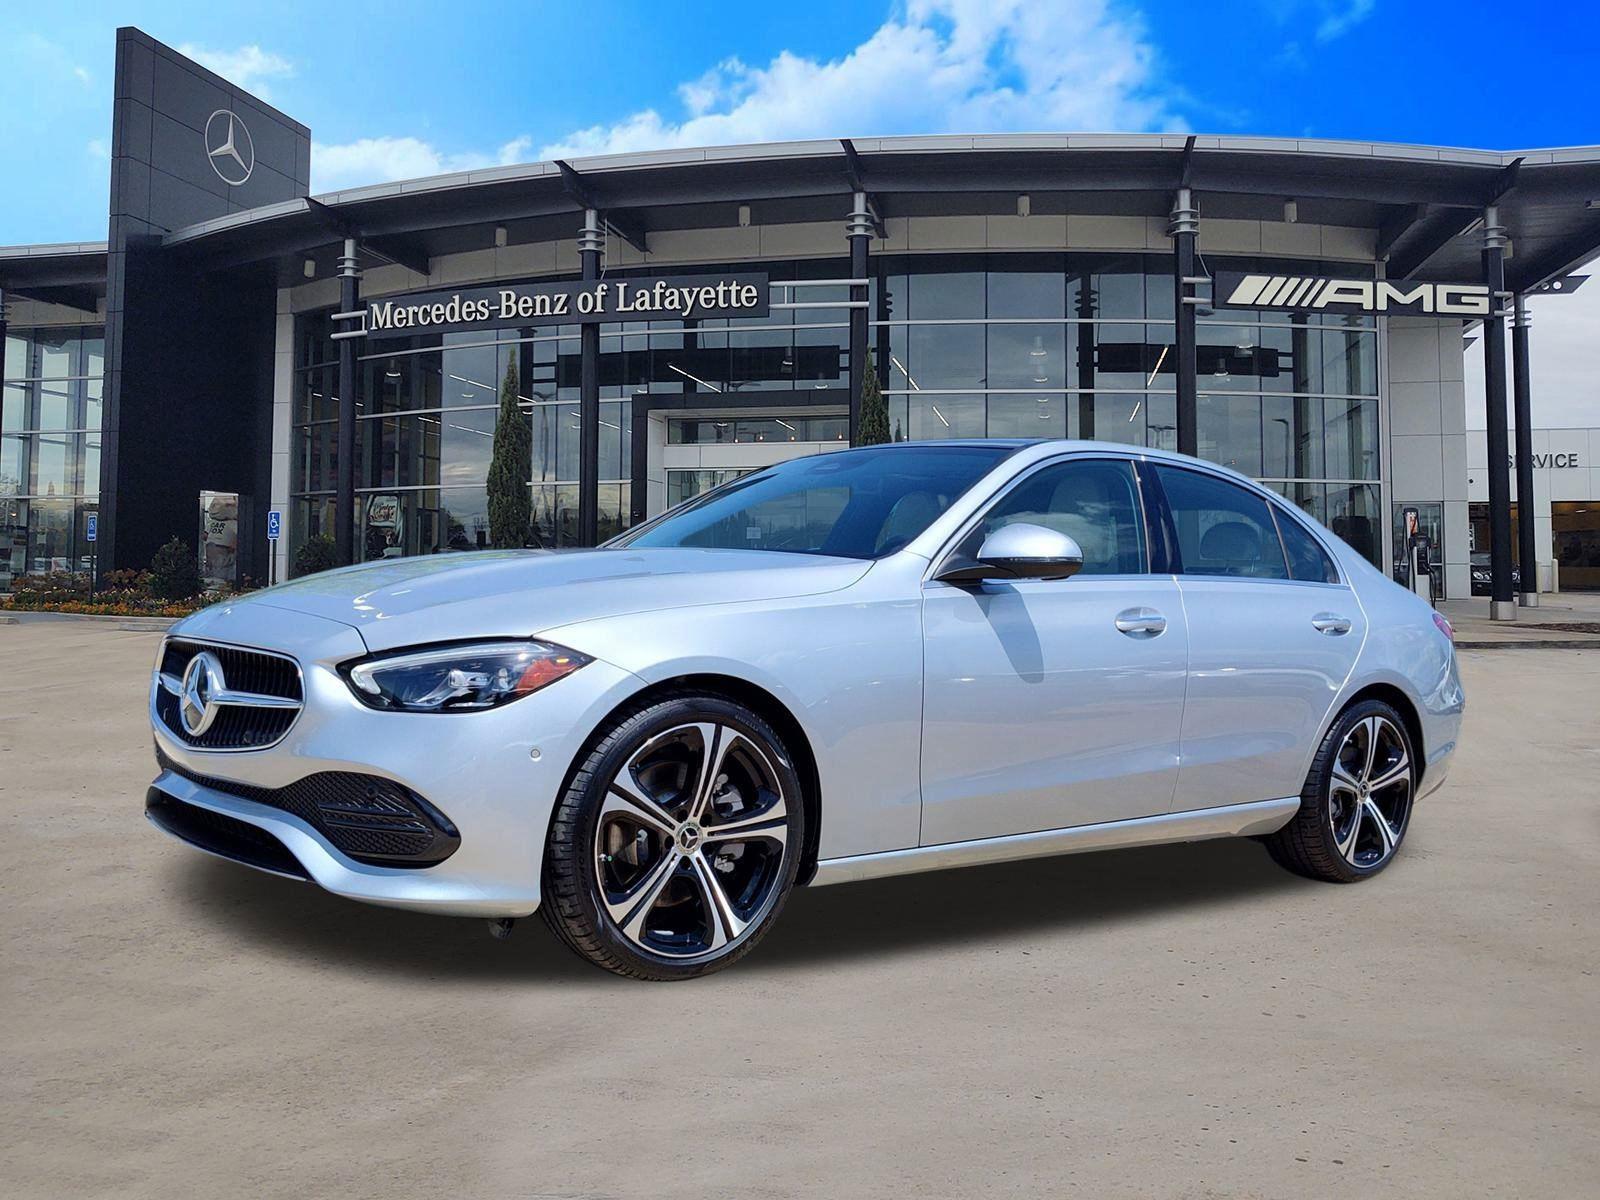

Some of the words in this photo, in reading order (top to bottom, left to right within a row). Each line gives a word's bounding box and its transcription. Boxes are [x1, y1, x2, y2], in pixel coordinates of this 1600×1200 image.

[370, 290, 568, 330] Mercedes-Benz
[577, 283, 607, 314] of
[615, 280, 758, 316] Lafayette
[1312, 279, 1489, 315] AMG
[1507, 453, 1579, 469] SRVICE
